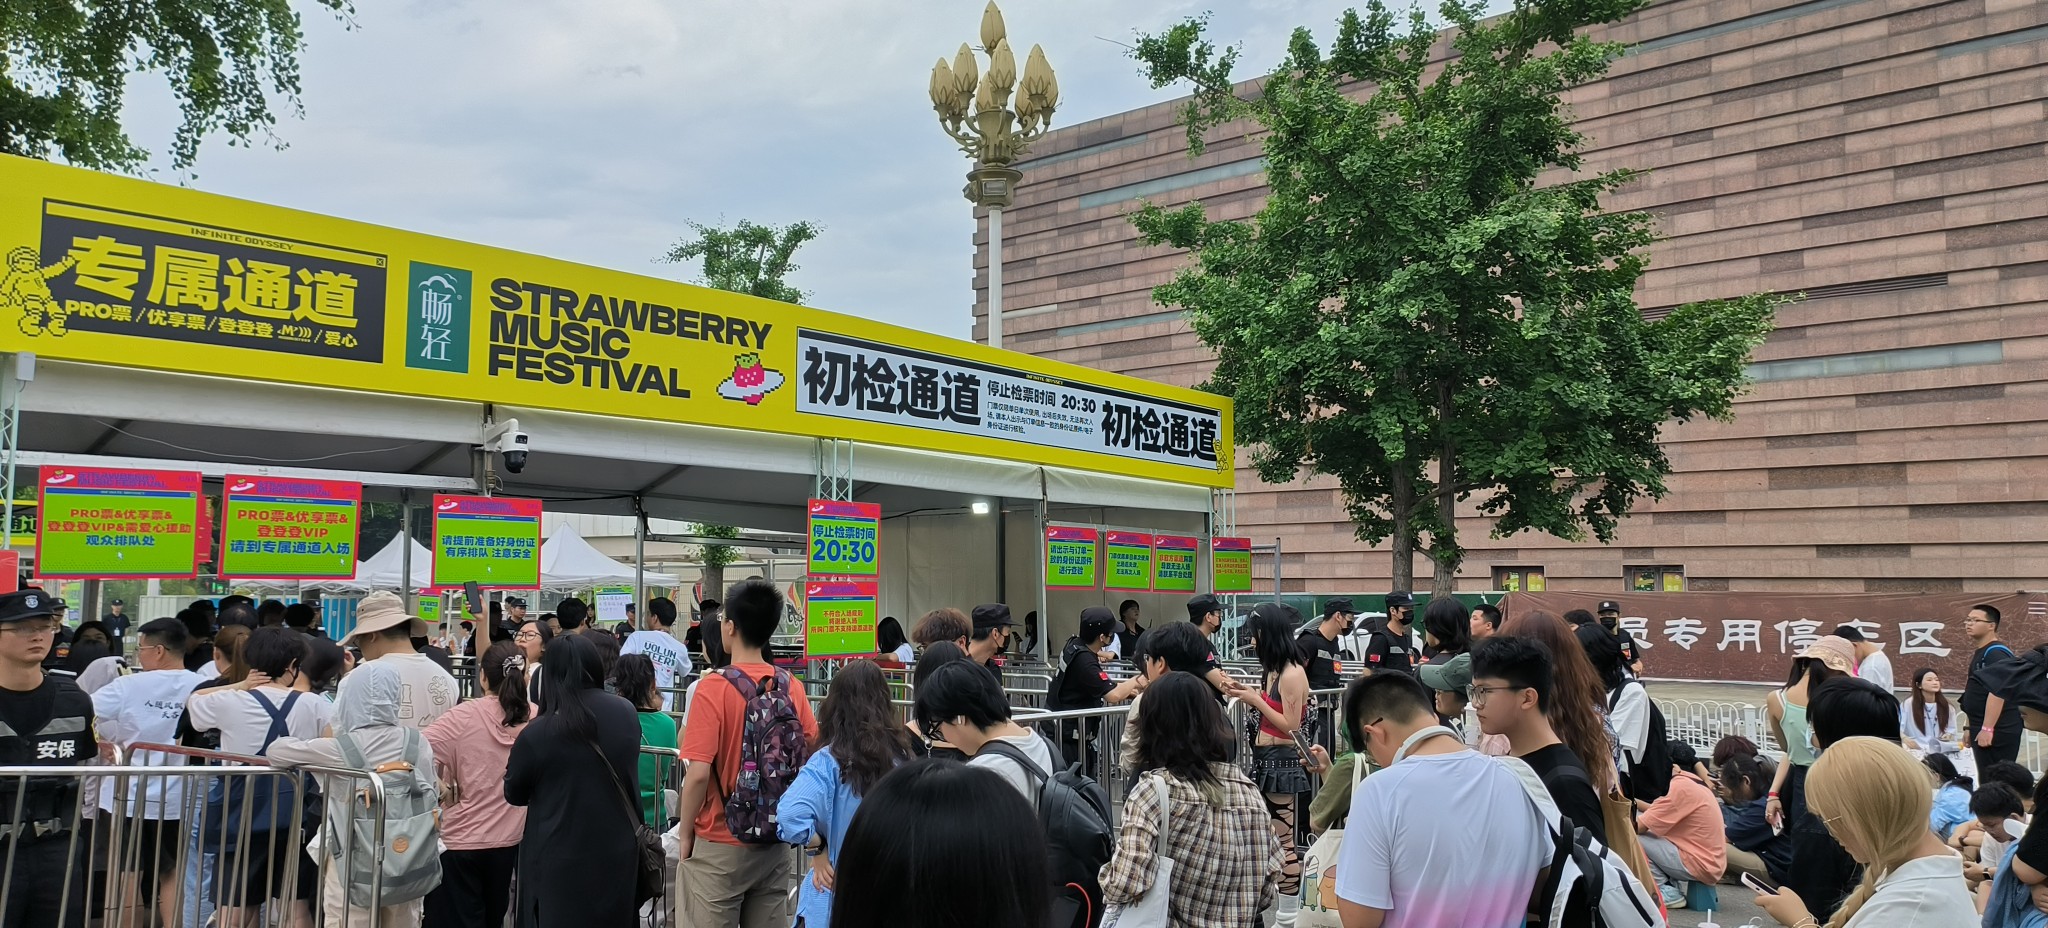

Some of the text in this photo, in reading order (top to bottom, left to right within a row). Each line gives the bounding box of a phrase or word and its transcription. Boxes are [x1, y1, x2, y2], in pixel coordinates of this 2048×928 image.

[190, 228, 294, 251] INFINITE ODYSSEY
[68, 235, 358, 328] 专属通道
[489, 277, 772, 350] STRAWBERRY
[420, 287, 452, 362] 畅轻
[490, 309, 631, 360] MUSIC
[488, 344, 691, 399] FESTIVAL
[803, 345, 982, 426] 初检通道
[987, 379, 1097, 414] 停止检票时间 20:30
[1101, 401, 1217, 462] 初检通道
[70, 509, 173, 520] PRO票&优享票&
[237, 509, 349, 524] PRO票&优享票&
[47, 522, 192, 533] 登登登VIP&需爱心援助
[257, 525, 329, 538] 登登登VIP
[813, 524, 876, 540] 停止检票时间
[86, 535, 155, 546] 观众排队处
[230, 540, 350, 555] 请到专属通道入场
[442, 535, 536, 548] 请提前准备好身份证
[446, 547, 532, 559] 有序排队 注意安全
[812, 539, 875, 563] 20:30
[644, 641, 677, 659] VOLUN
[37, 740, 76, 760] 安保
